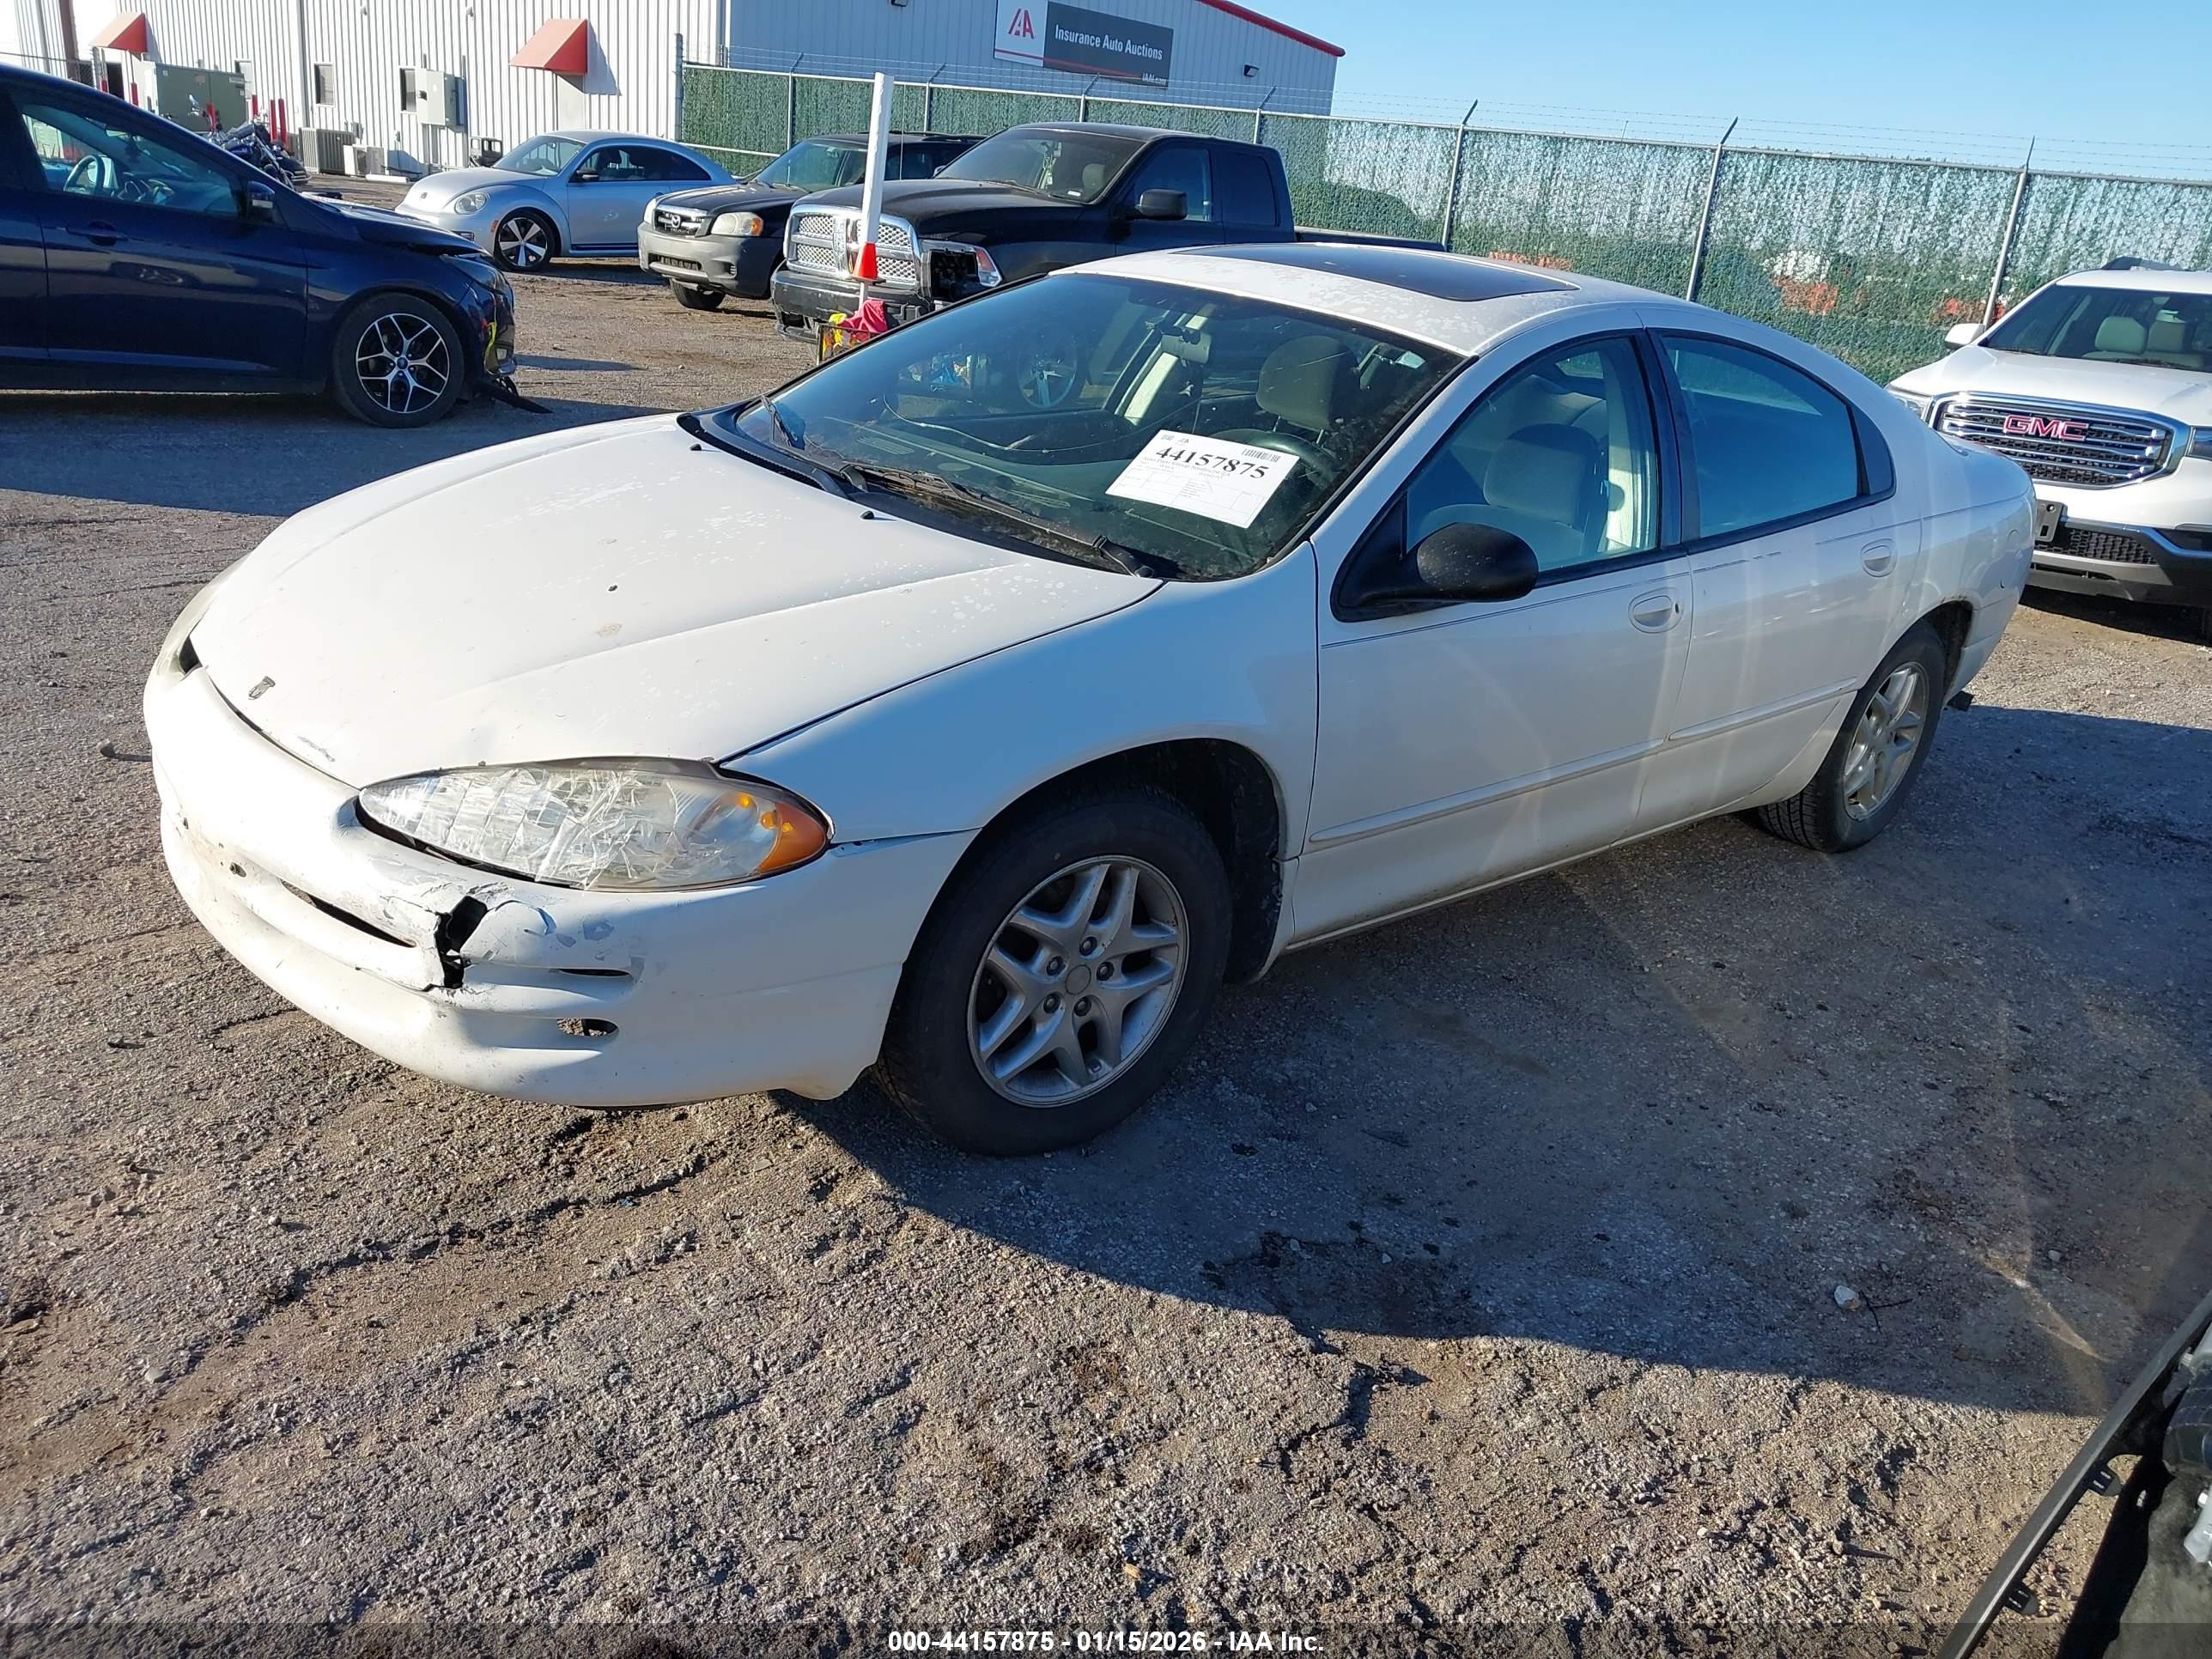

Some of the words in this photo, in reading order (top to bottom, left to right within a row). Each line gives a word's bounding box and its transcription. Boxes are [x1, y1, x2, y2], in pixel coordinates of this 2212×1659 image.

[1054, 24, 1101, 47] Insurance
[1103, 34, 1123, 52] Auto
[1125, 40, 1164, 60] Auctions
[2003, 415, 2088, 441] GMC
[1156, 447, 1269, 479] 44157875
